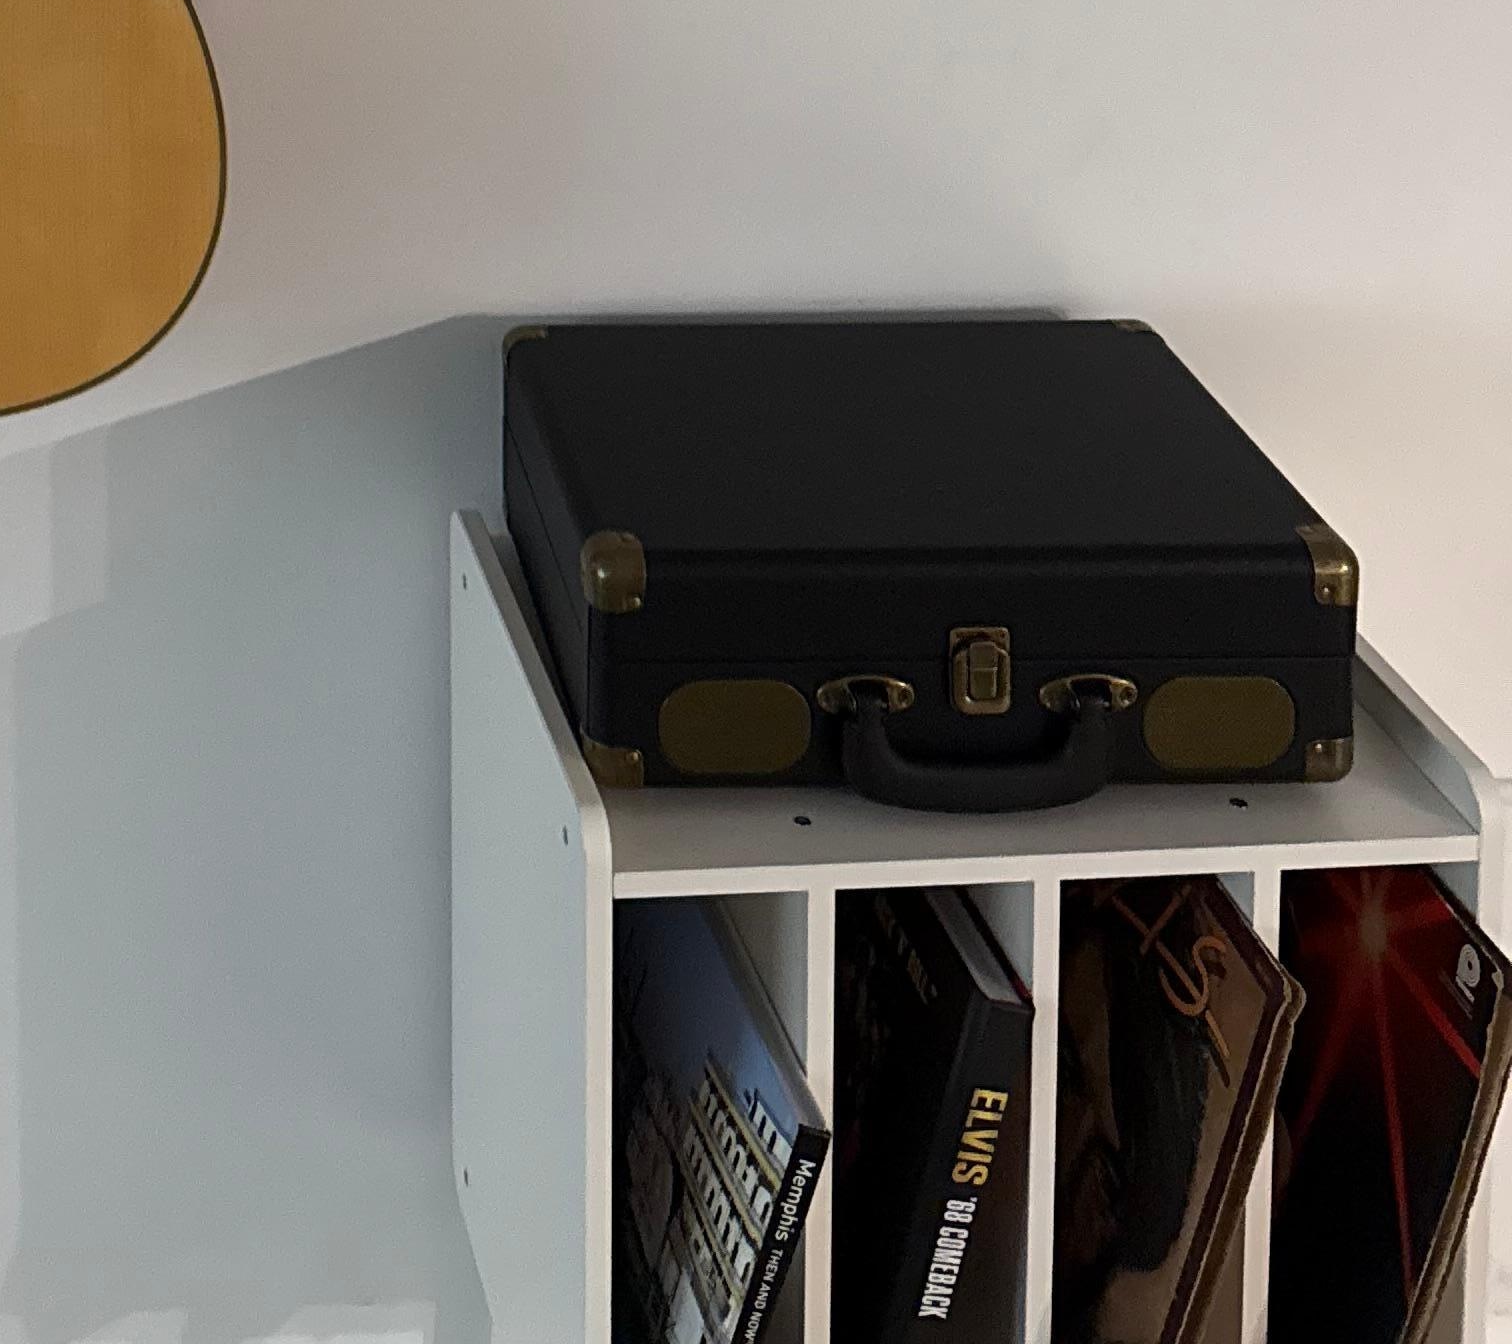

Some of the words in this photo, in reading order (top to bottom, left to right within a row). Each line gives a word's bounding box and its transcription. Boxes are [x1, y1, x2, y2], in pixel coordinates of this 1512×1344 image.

[951, 1087, 1009, 1188] ELVIS
[775, 1159, 817, 1242] Memphis
[943, 1195, 979, 1224] '68
[763, 1248, 784, 1282] THEN
[918, 1226, 970, 1320] COMEBACK
[754, 1282, 772, 1310] AND
[743, 1312, 763, 1344] NOW
